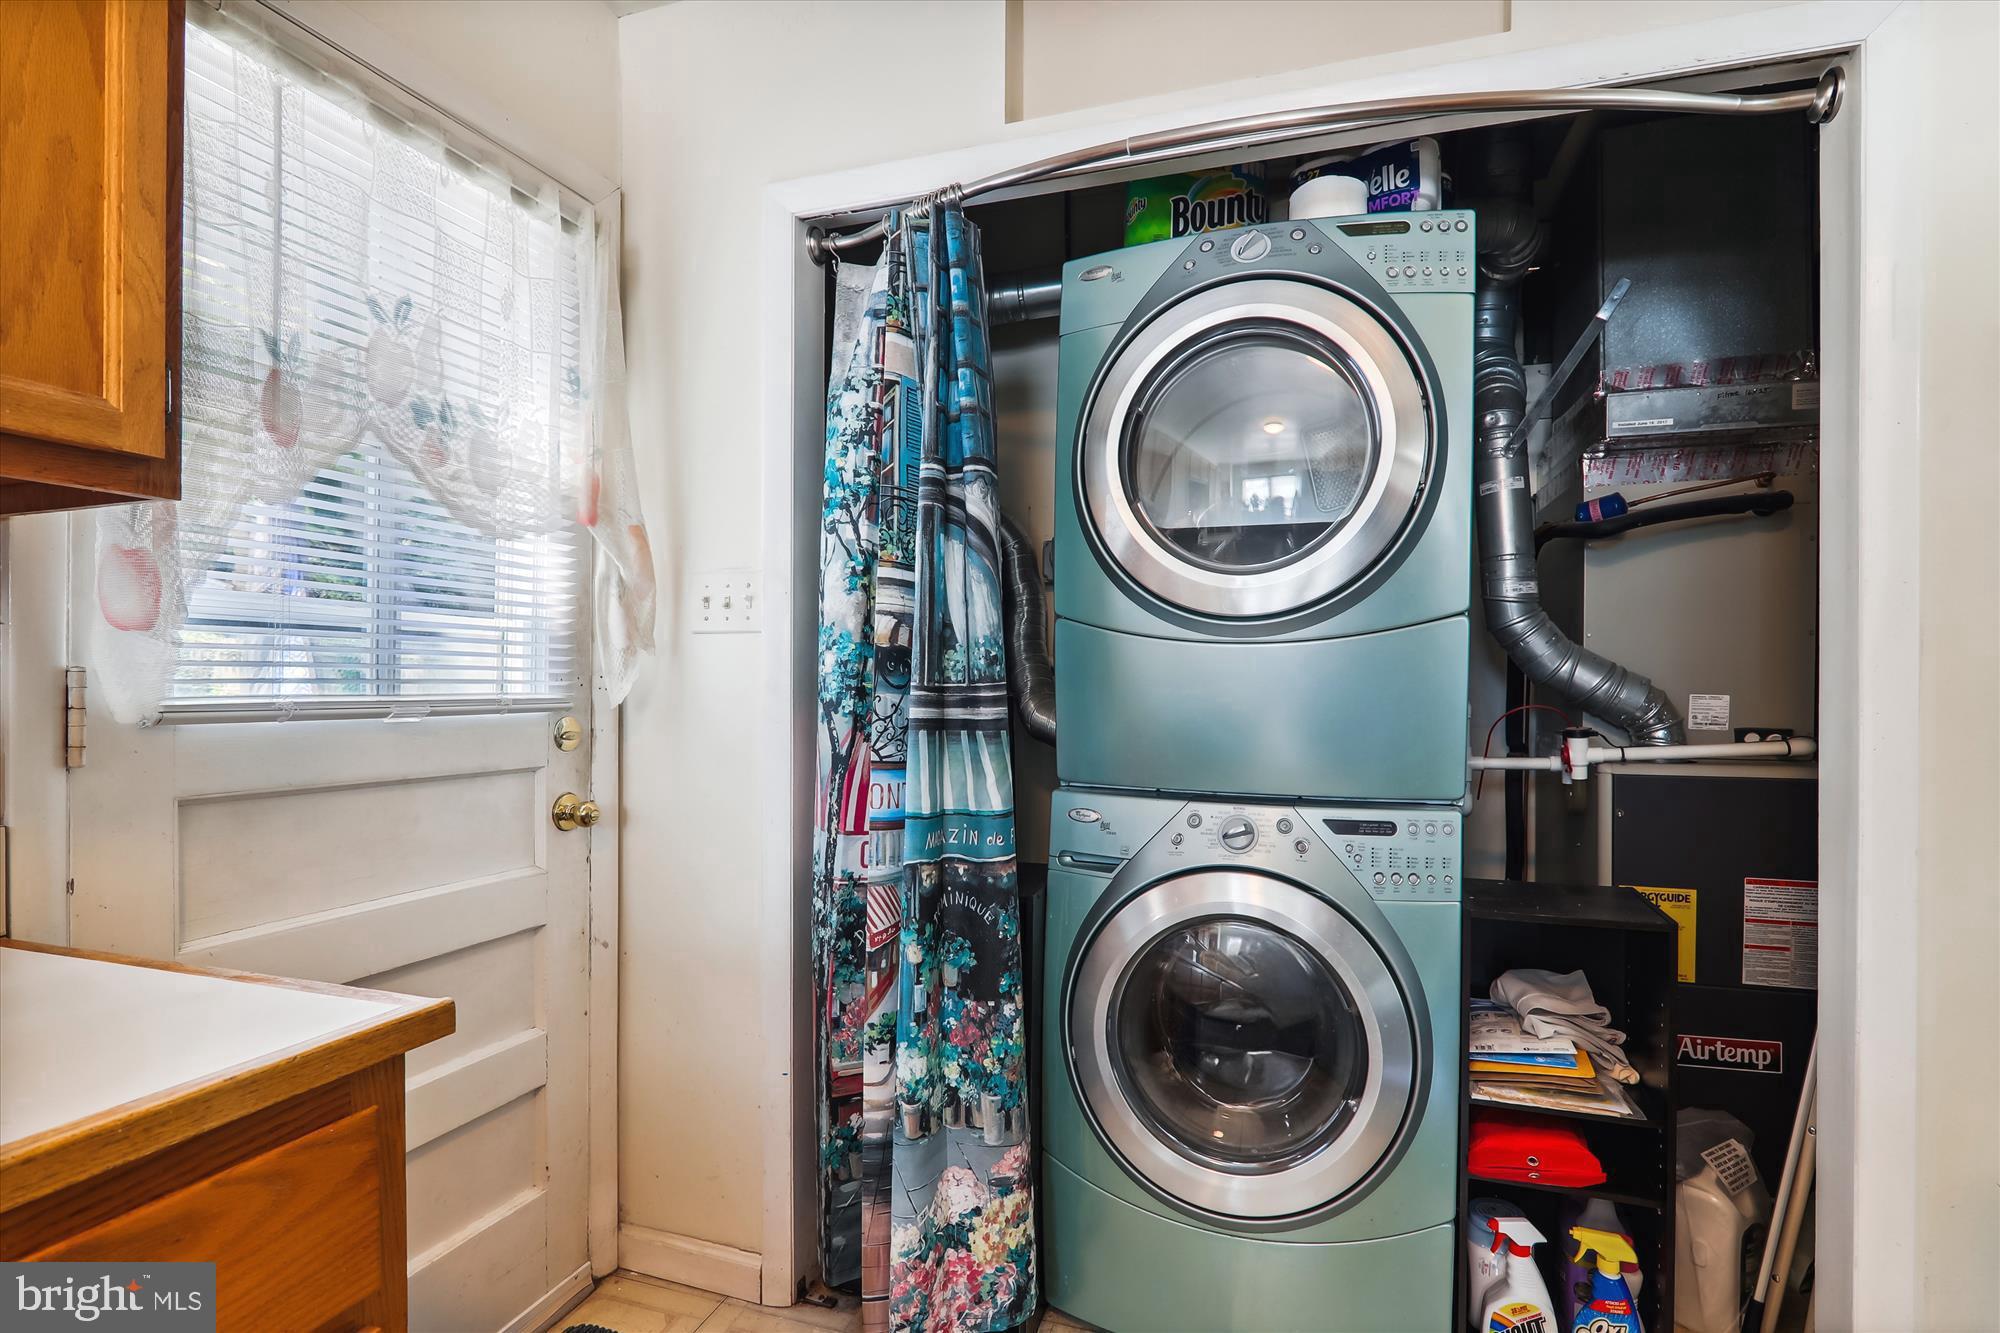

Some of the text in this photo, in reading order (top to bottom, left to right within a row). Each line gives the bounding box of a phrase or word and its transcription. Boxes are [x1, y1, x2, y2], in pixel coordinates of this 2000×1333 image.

[1170, 188, 1265, 239] Bounty
[1368, 188, 1420, 213] MFORT
[986, 832, 1005, 846] de
[1677, 1037, 1772, 1070] Airtemp
